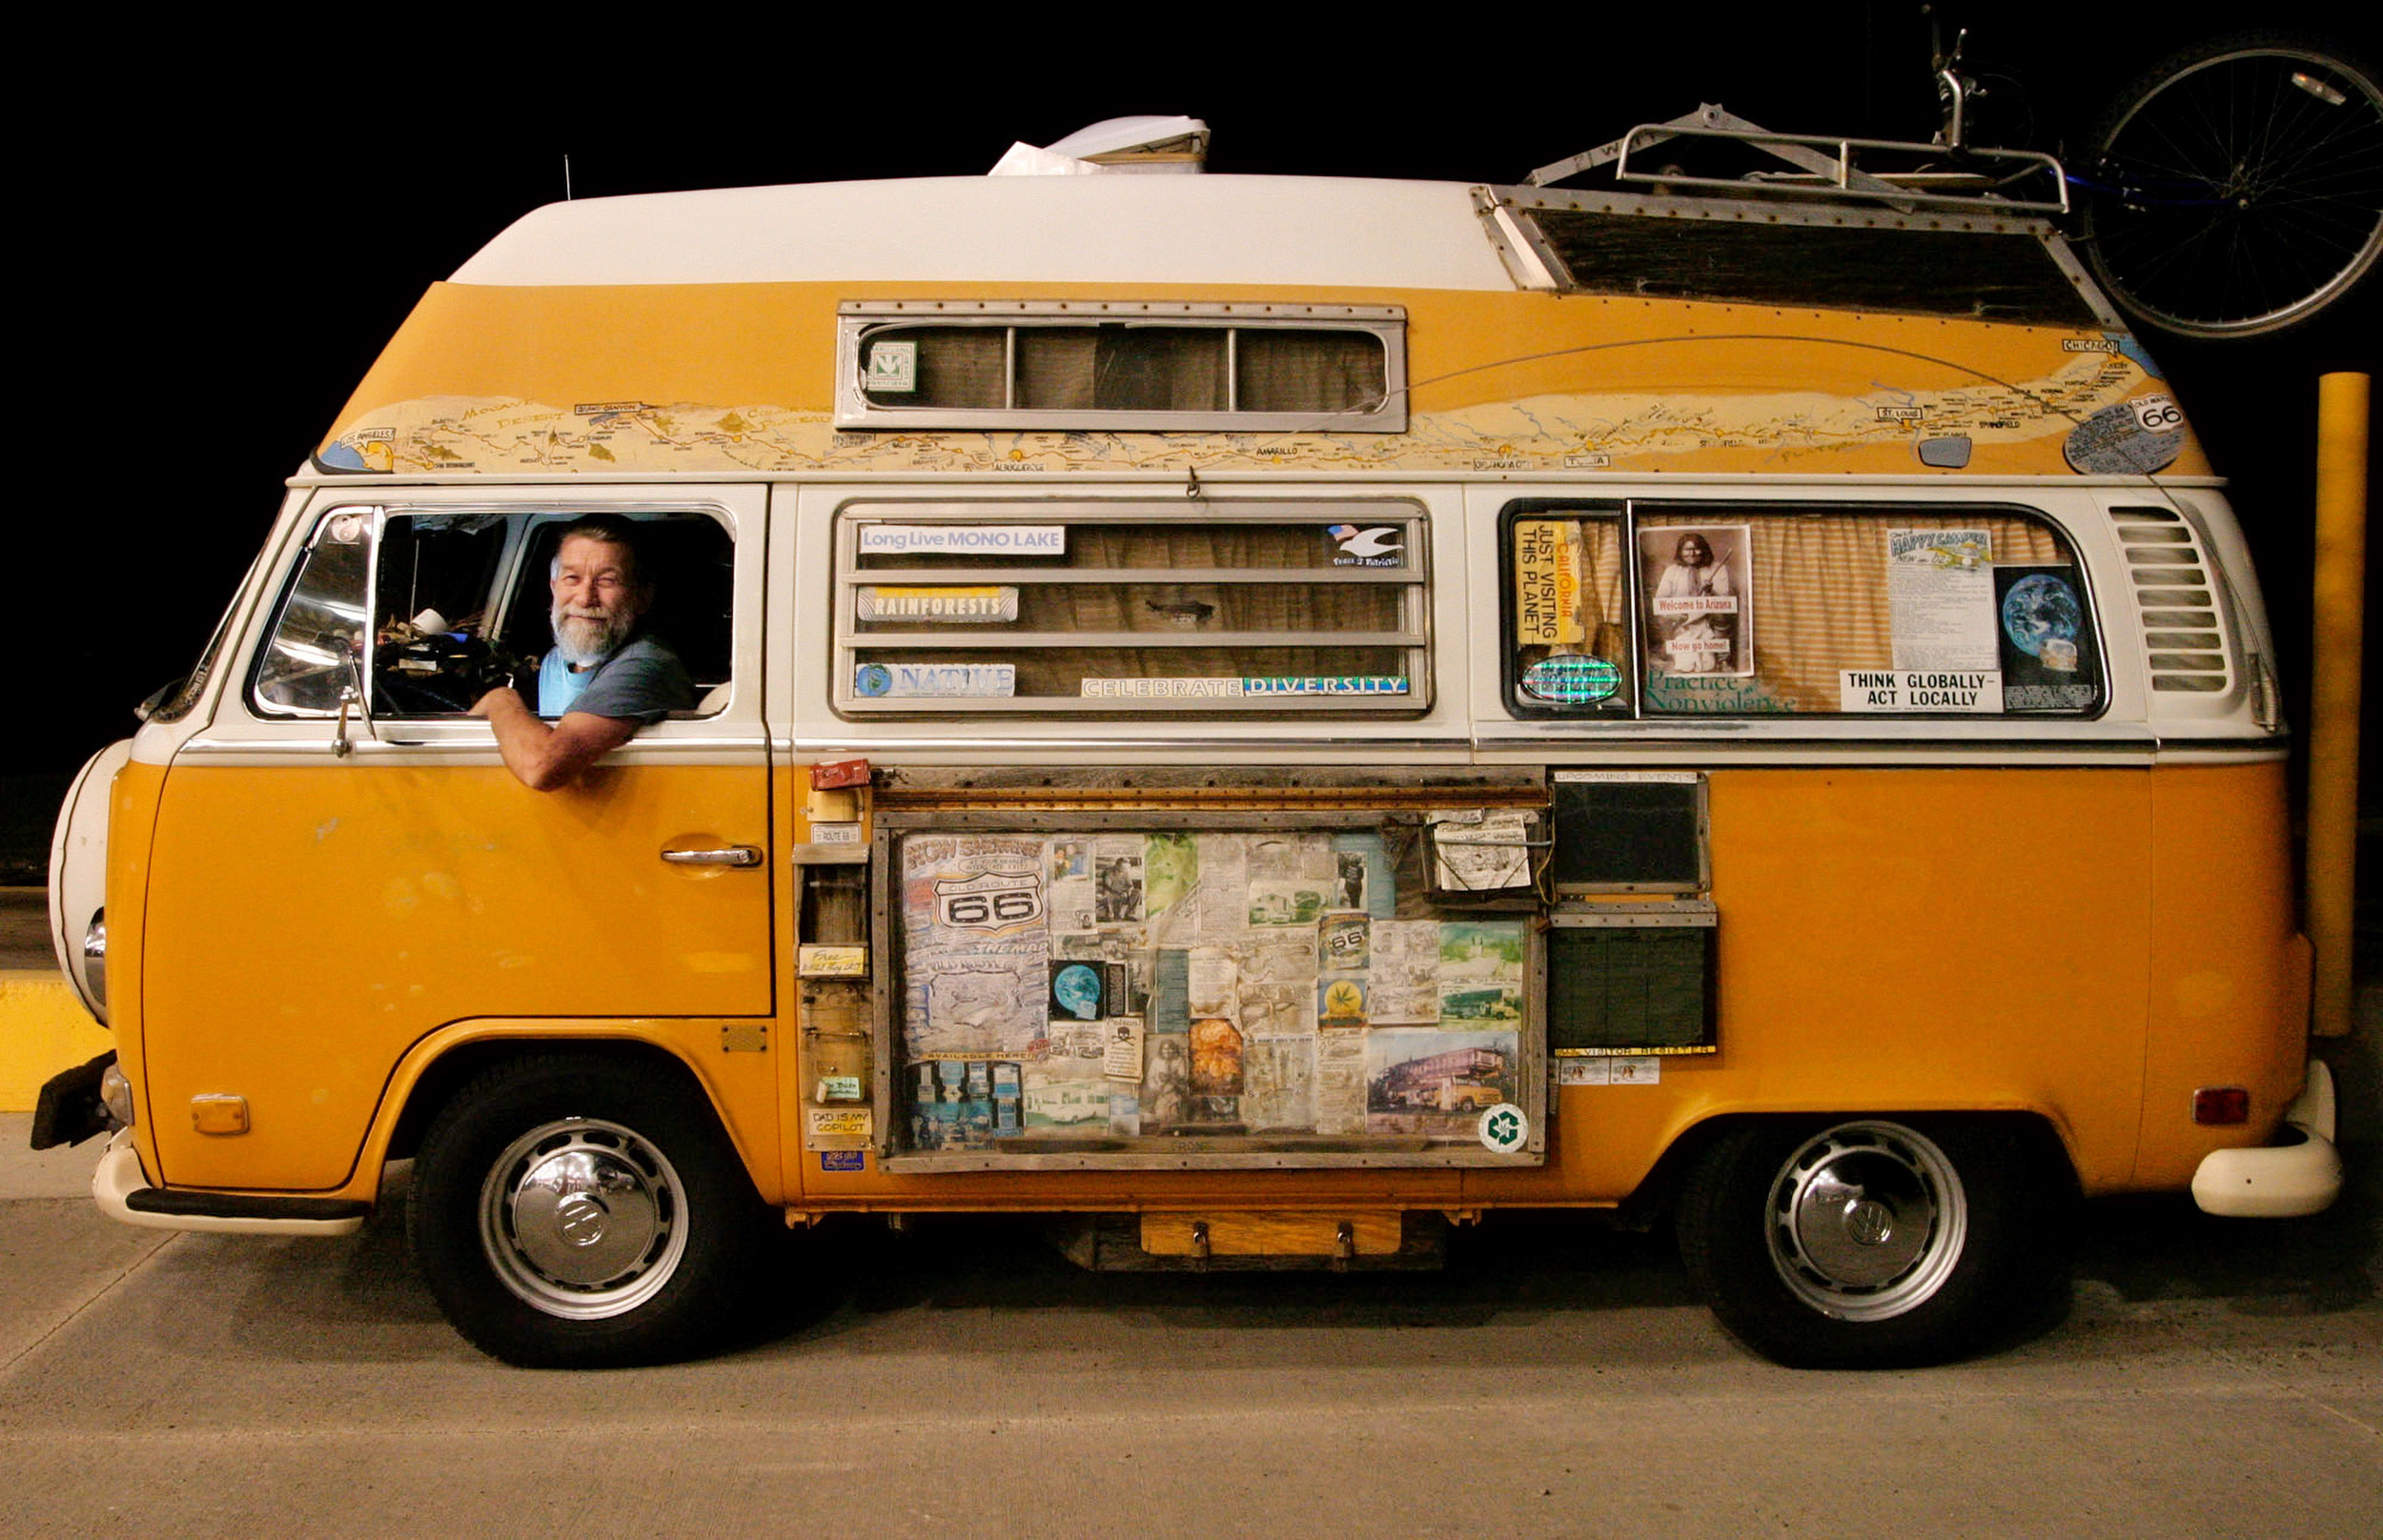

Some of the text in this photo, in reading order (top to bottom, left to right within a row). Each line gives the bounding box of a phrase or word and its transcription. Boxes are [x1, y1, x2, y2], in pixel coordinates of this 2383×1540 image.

[2143, 406, 2181, 427] 66
[1256, 447, 1297, 456] AMARILLO
[864, 532, 1059, 549] Long Live MONO LAKE
[1522, 530, 1539, 635] THIS PLANET
[1538, 525, 1557, 638] JUST VISITING
[1557, 543, 1573, 617] CALIFORNIA
[875, 598, 1000, 616] RAINFORESTS
[1660, 599, 1732, 610] Welcome to Arizona
[1692, 643, 1702, 652] go
[1704, 641, 1726, 650] home!
[900, 668, 1013, 691] NATIVE
[1084, 677, 1403, 697] CELEBRATE DIVERSITY
[1648, 669, 1739, 690] Practice
[1849, 674, 1896, 687] THINK
[1867, 691, 1978, 706] ACT LOCALLY
[1556, 772, 1695, 781] UPCOMING EVENTS
[906, 840, 957, 869] NOW
[980, 880, 1029, 890] ROUTE
[948, 892, 1034, 923] 66
[1332, 932, 1362, 949] 66
[813, 1112, 868, 1122] DAD IS MY
[817, 1124, 865, 1132] COPILOT
